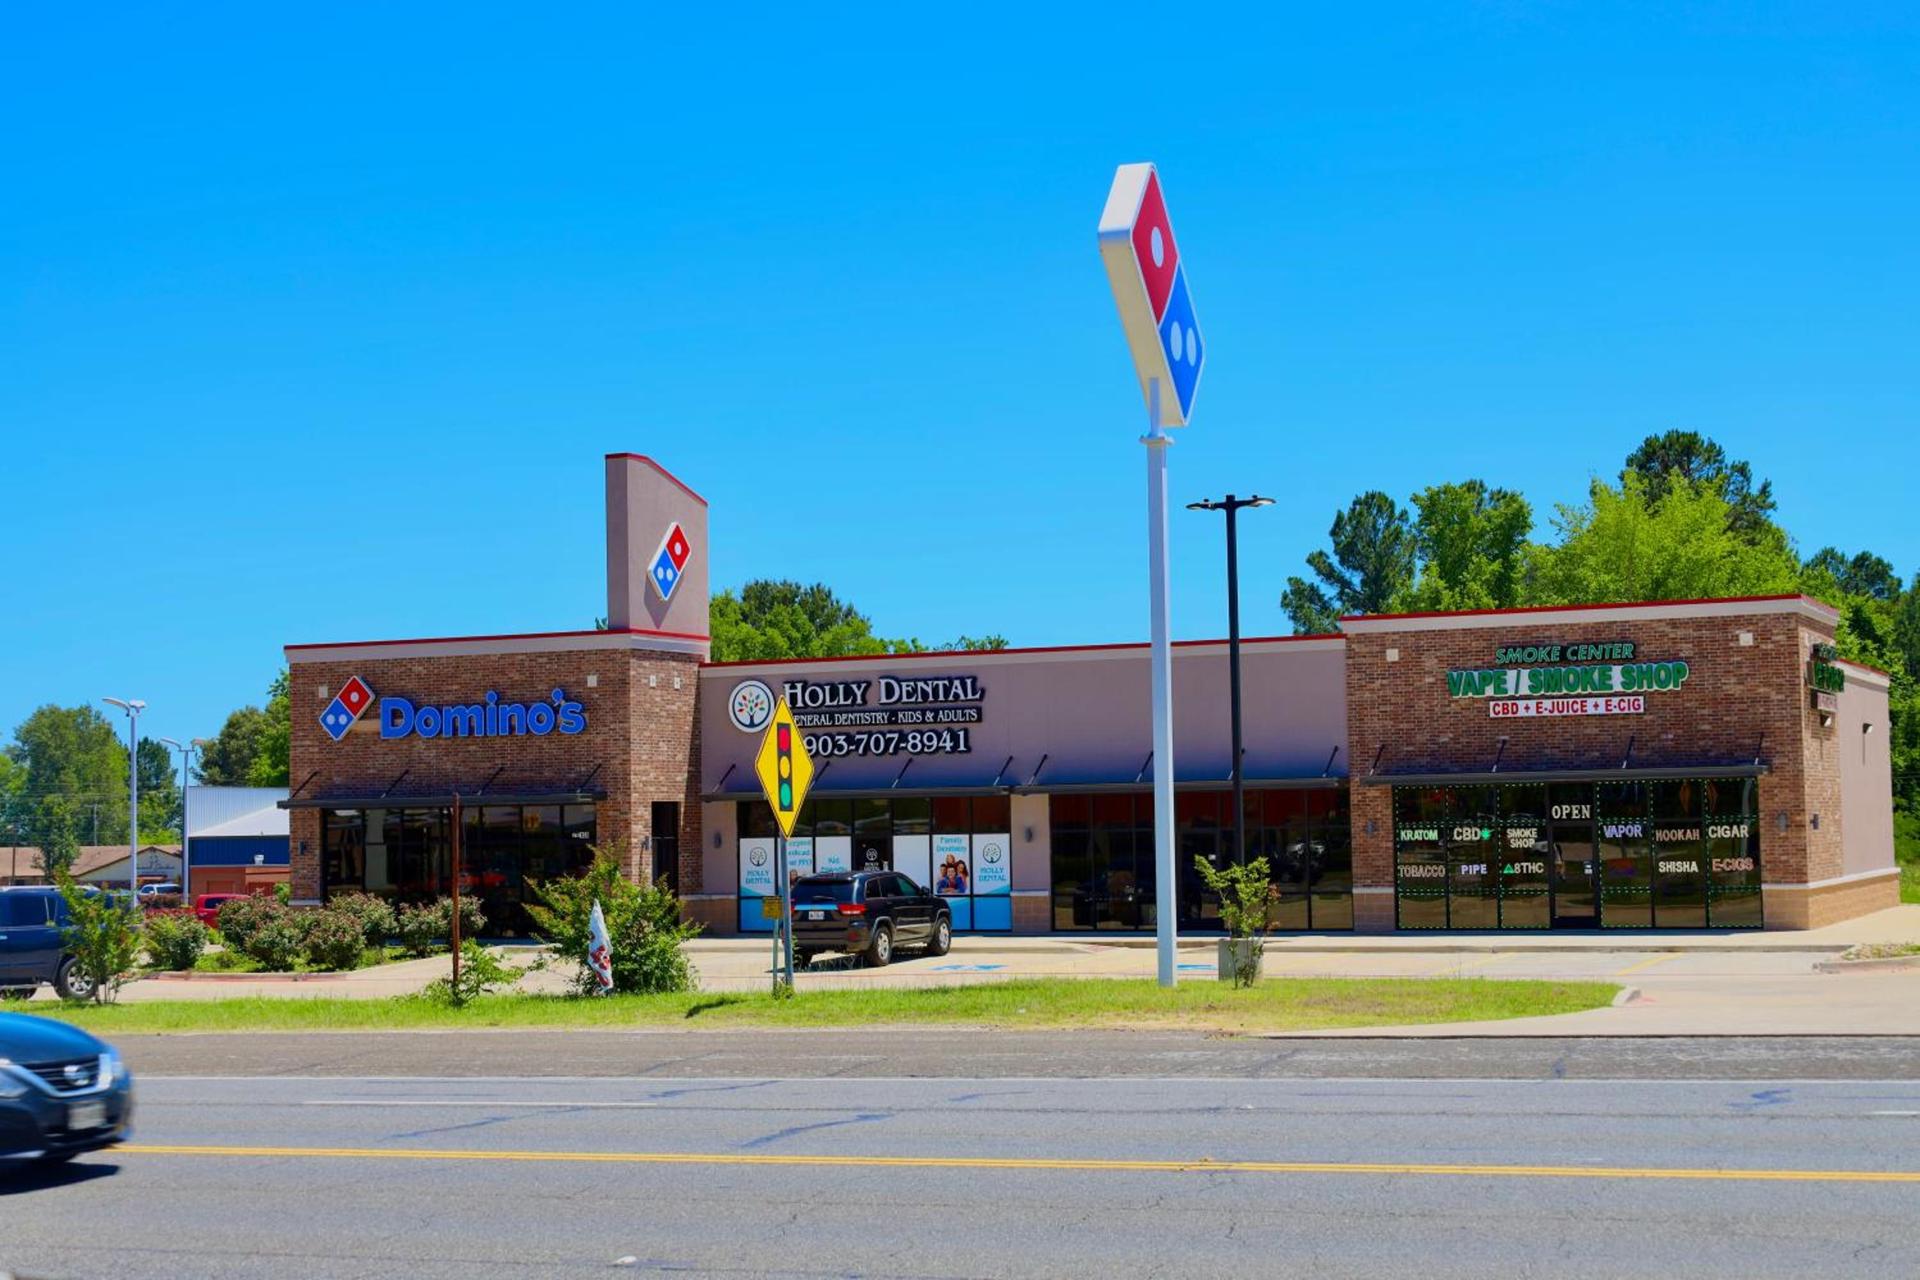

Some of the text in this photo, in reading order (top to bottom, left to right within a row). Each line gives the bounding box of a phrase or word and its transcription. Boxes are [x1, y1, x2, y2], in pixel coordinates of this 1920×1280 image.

[1495, 643, 1634, 664] SMOKE CENTER
[1447, 669, 1508, 697] VAPE
[1527, 667, 1613, 694] SMOKE
[1620, 662, 1688, 691] SHOP
[783, 677, 982, 707] HOLLY DENTAL
[380, 688, 585, 739] Domino's
[1492, 702, 1519, 715] CBD
[1535, 700, 1588, 714] E-JUICE
[1604, 698, 1642, 712] E-CIG
[794, 713, 833, 726] ENERAL
[835, 711, 889, 725] DENTISTRY
[898, 710, 922, 723] KIDS
[937, 708, 977, 722] ADULTS
[804, 730, 967, 756] 903-707-8941
[1551, 804, 1591, 819] OPEN
[1400, 828, 1439, 841] KRATOM
[1453, 826, 1481, 841] CBD
[1507, 828, 1538, 839] SMOKE
[1603, 824, 1642, 838] VAPOR
[1656, 829, 1700, 842] HOOKAH
[1708, 824, 1749, 838] CIGAR
[1510, 838, 1536, 849] SHOP
[1400, 864, 1446, 878] TOBACCO
[1461, 864, 1488, 875] PIPE
[1658, 861, 1699, 873] SHISHA
[1711, 858, 1754, 872] E-CIGS
